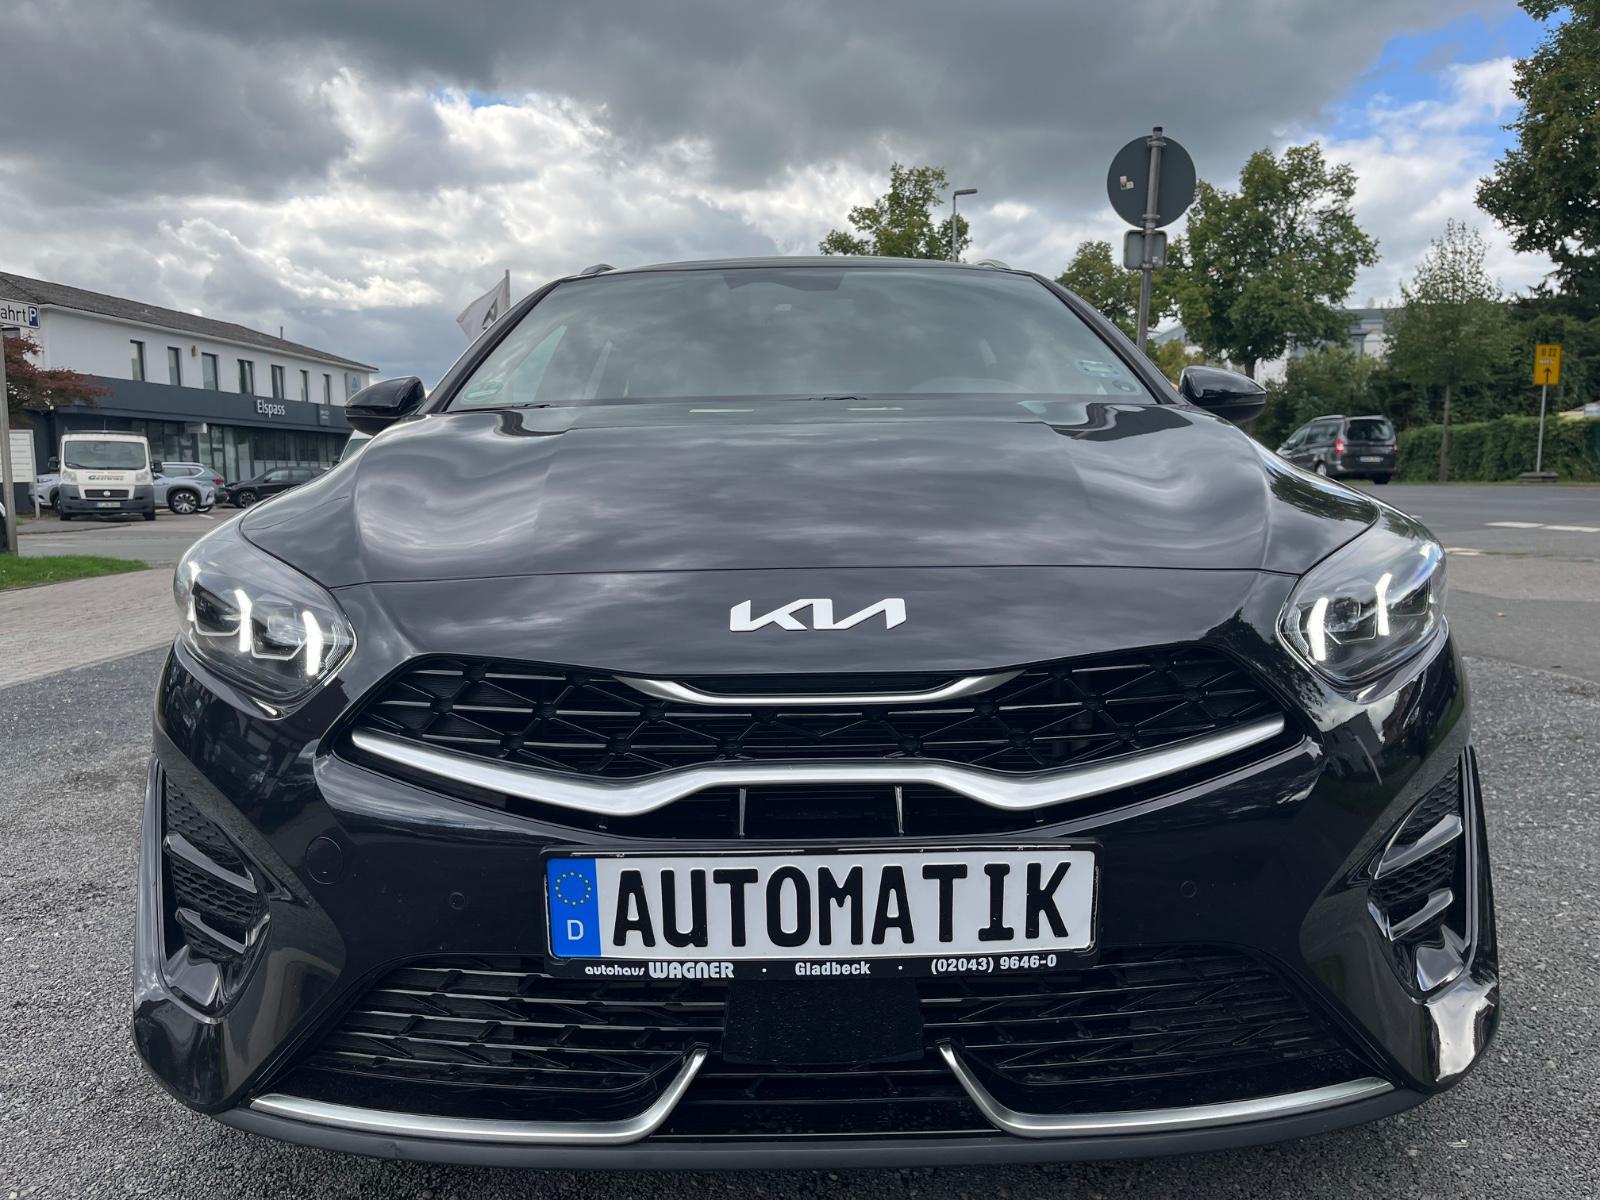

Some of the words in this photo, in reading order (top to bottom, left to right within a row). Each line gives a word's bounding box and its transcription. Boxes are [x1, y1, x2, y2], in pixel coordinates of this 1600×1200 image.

[256, 399, 286, 418] Elspass
[729, 597, 907, 632] KIA
[612, 861, 1072, 948] AUTOMATIK
[566, 919, 584, 941] D
[584, 964, 646, 977] autohaus
[647, 961, 735, 979] WAGNER
[794, 960, 871, 977] Gladbeck
[930, 957, 994, 975] (02043)
[999, 954, 1057, 971] 9646-0
